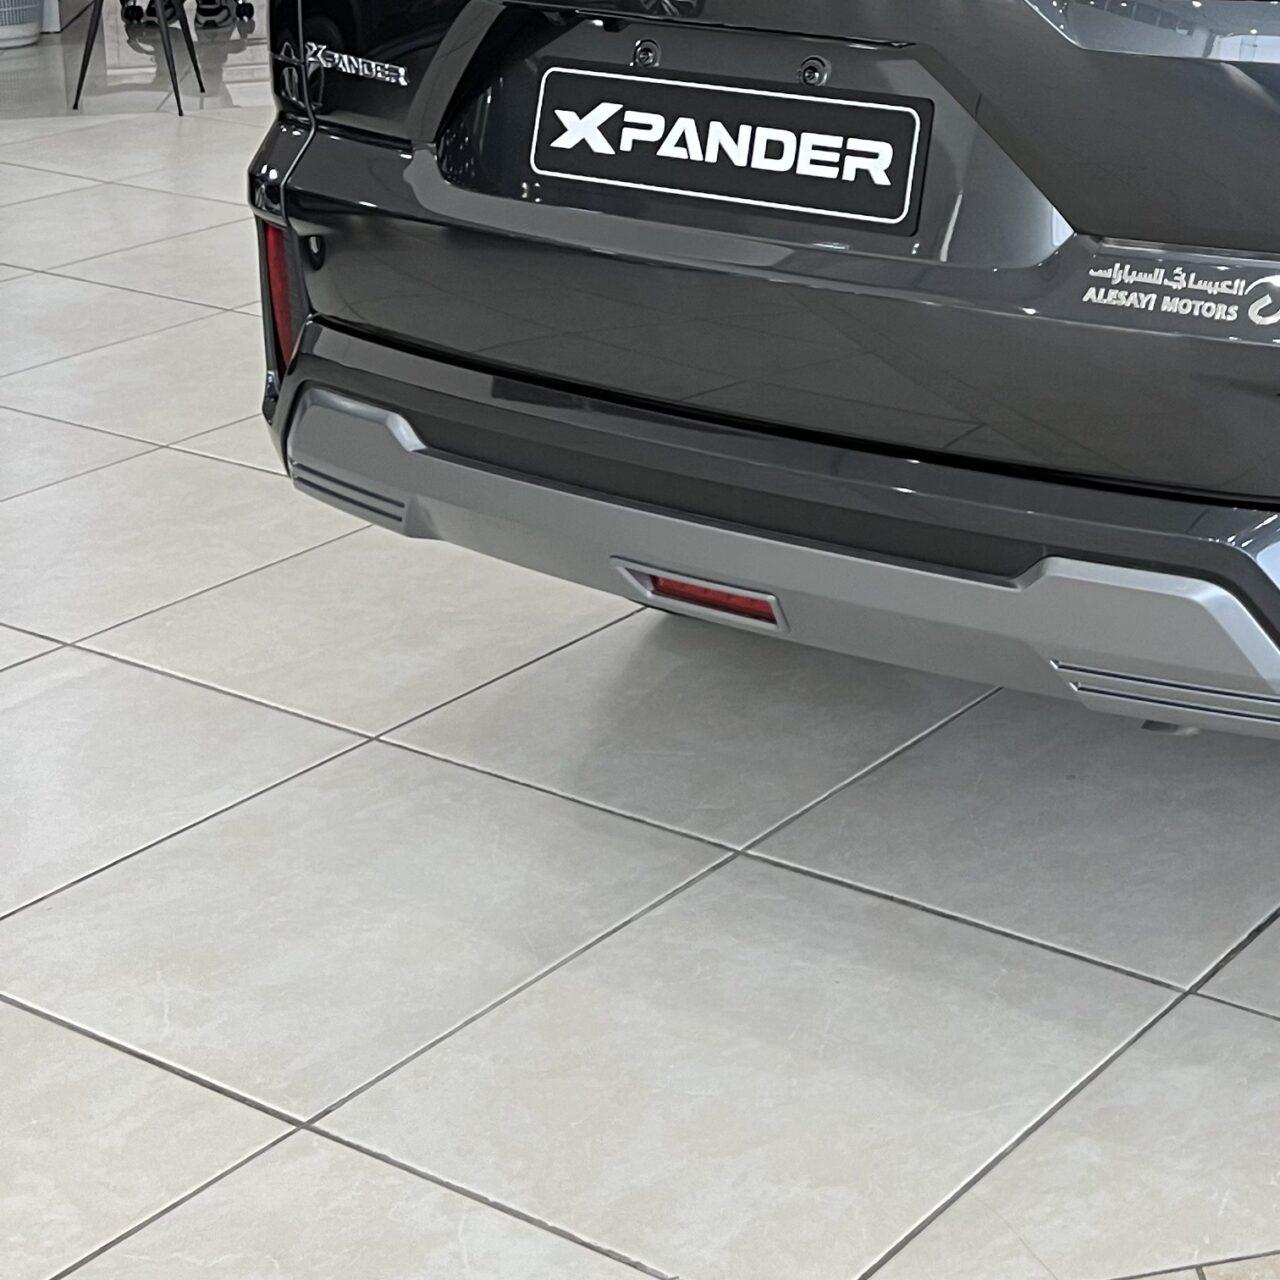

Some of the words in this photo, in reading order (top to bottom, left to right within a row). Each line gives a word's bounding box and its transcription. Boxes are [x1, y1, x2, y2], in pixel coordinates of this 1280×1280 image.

[305, 41, 408, 86] XPANDER
[550, 102, 893, 186] XPANDER
[1089, 263, 1165, 285] للسيارات
[1082, 287, 1157, 311] ALESAYI
[1161, 296, 1239, 321] MOTORS
